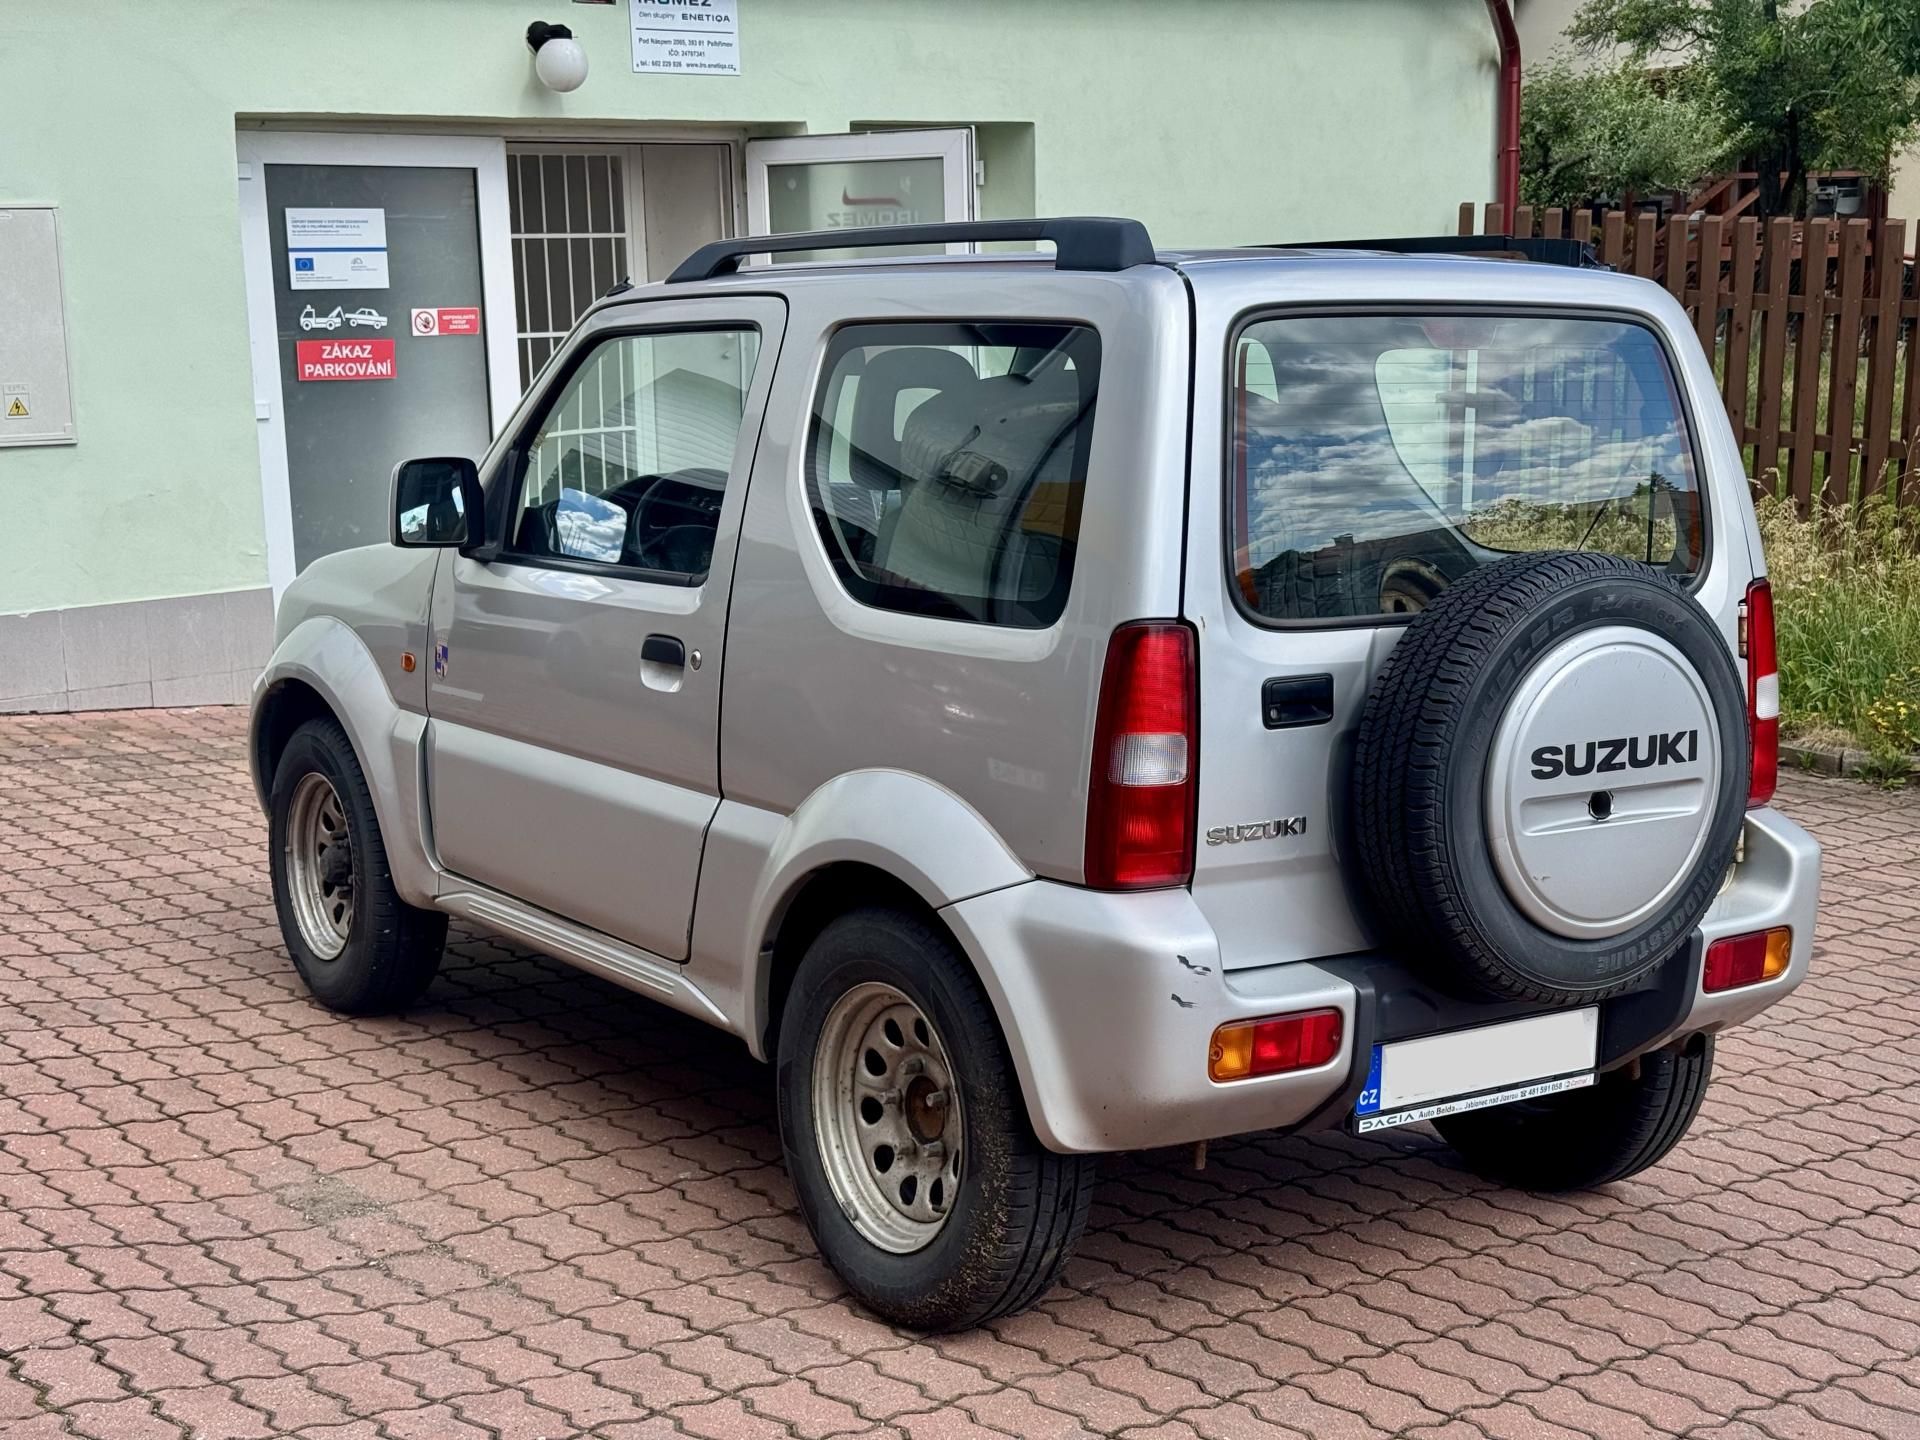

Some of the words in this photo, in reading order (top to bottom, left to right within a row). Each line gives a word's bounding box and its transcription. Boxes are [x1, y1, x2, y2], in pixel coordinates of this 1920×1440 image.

[653, 11, 675, 20] skupiny
[681, 13, 731, 23] ENETIQA
[321, 342, 373, 359] ZÁKAZ
[303, 359, 392, 377] PARKOVÁNÍ
[1530, 729, 1698, 780] SUZUKI
[1206, 816, 1307, 847] SUZUKI
[1359, 1088, 1378, 1106] CZ
[1361, 1113, 1415, 1131] DACIA
[1418, 1110, 1435, 1119] Auto
[1464, 1099, 1488, 1110] Jablonec
[1488, 1096, 1499, 1104] nad
[1528, 1087, 1539, 1096] 481
[1540, 1085, 1551, 1094] 591
[1551, 1082, 1563, 1091] 058
